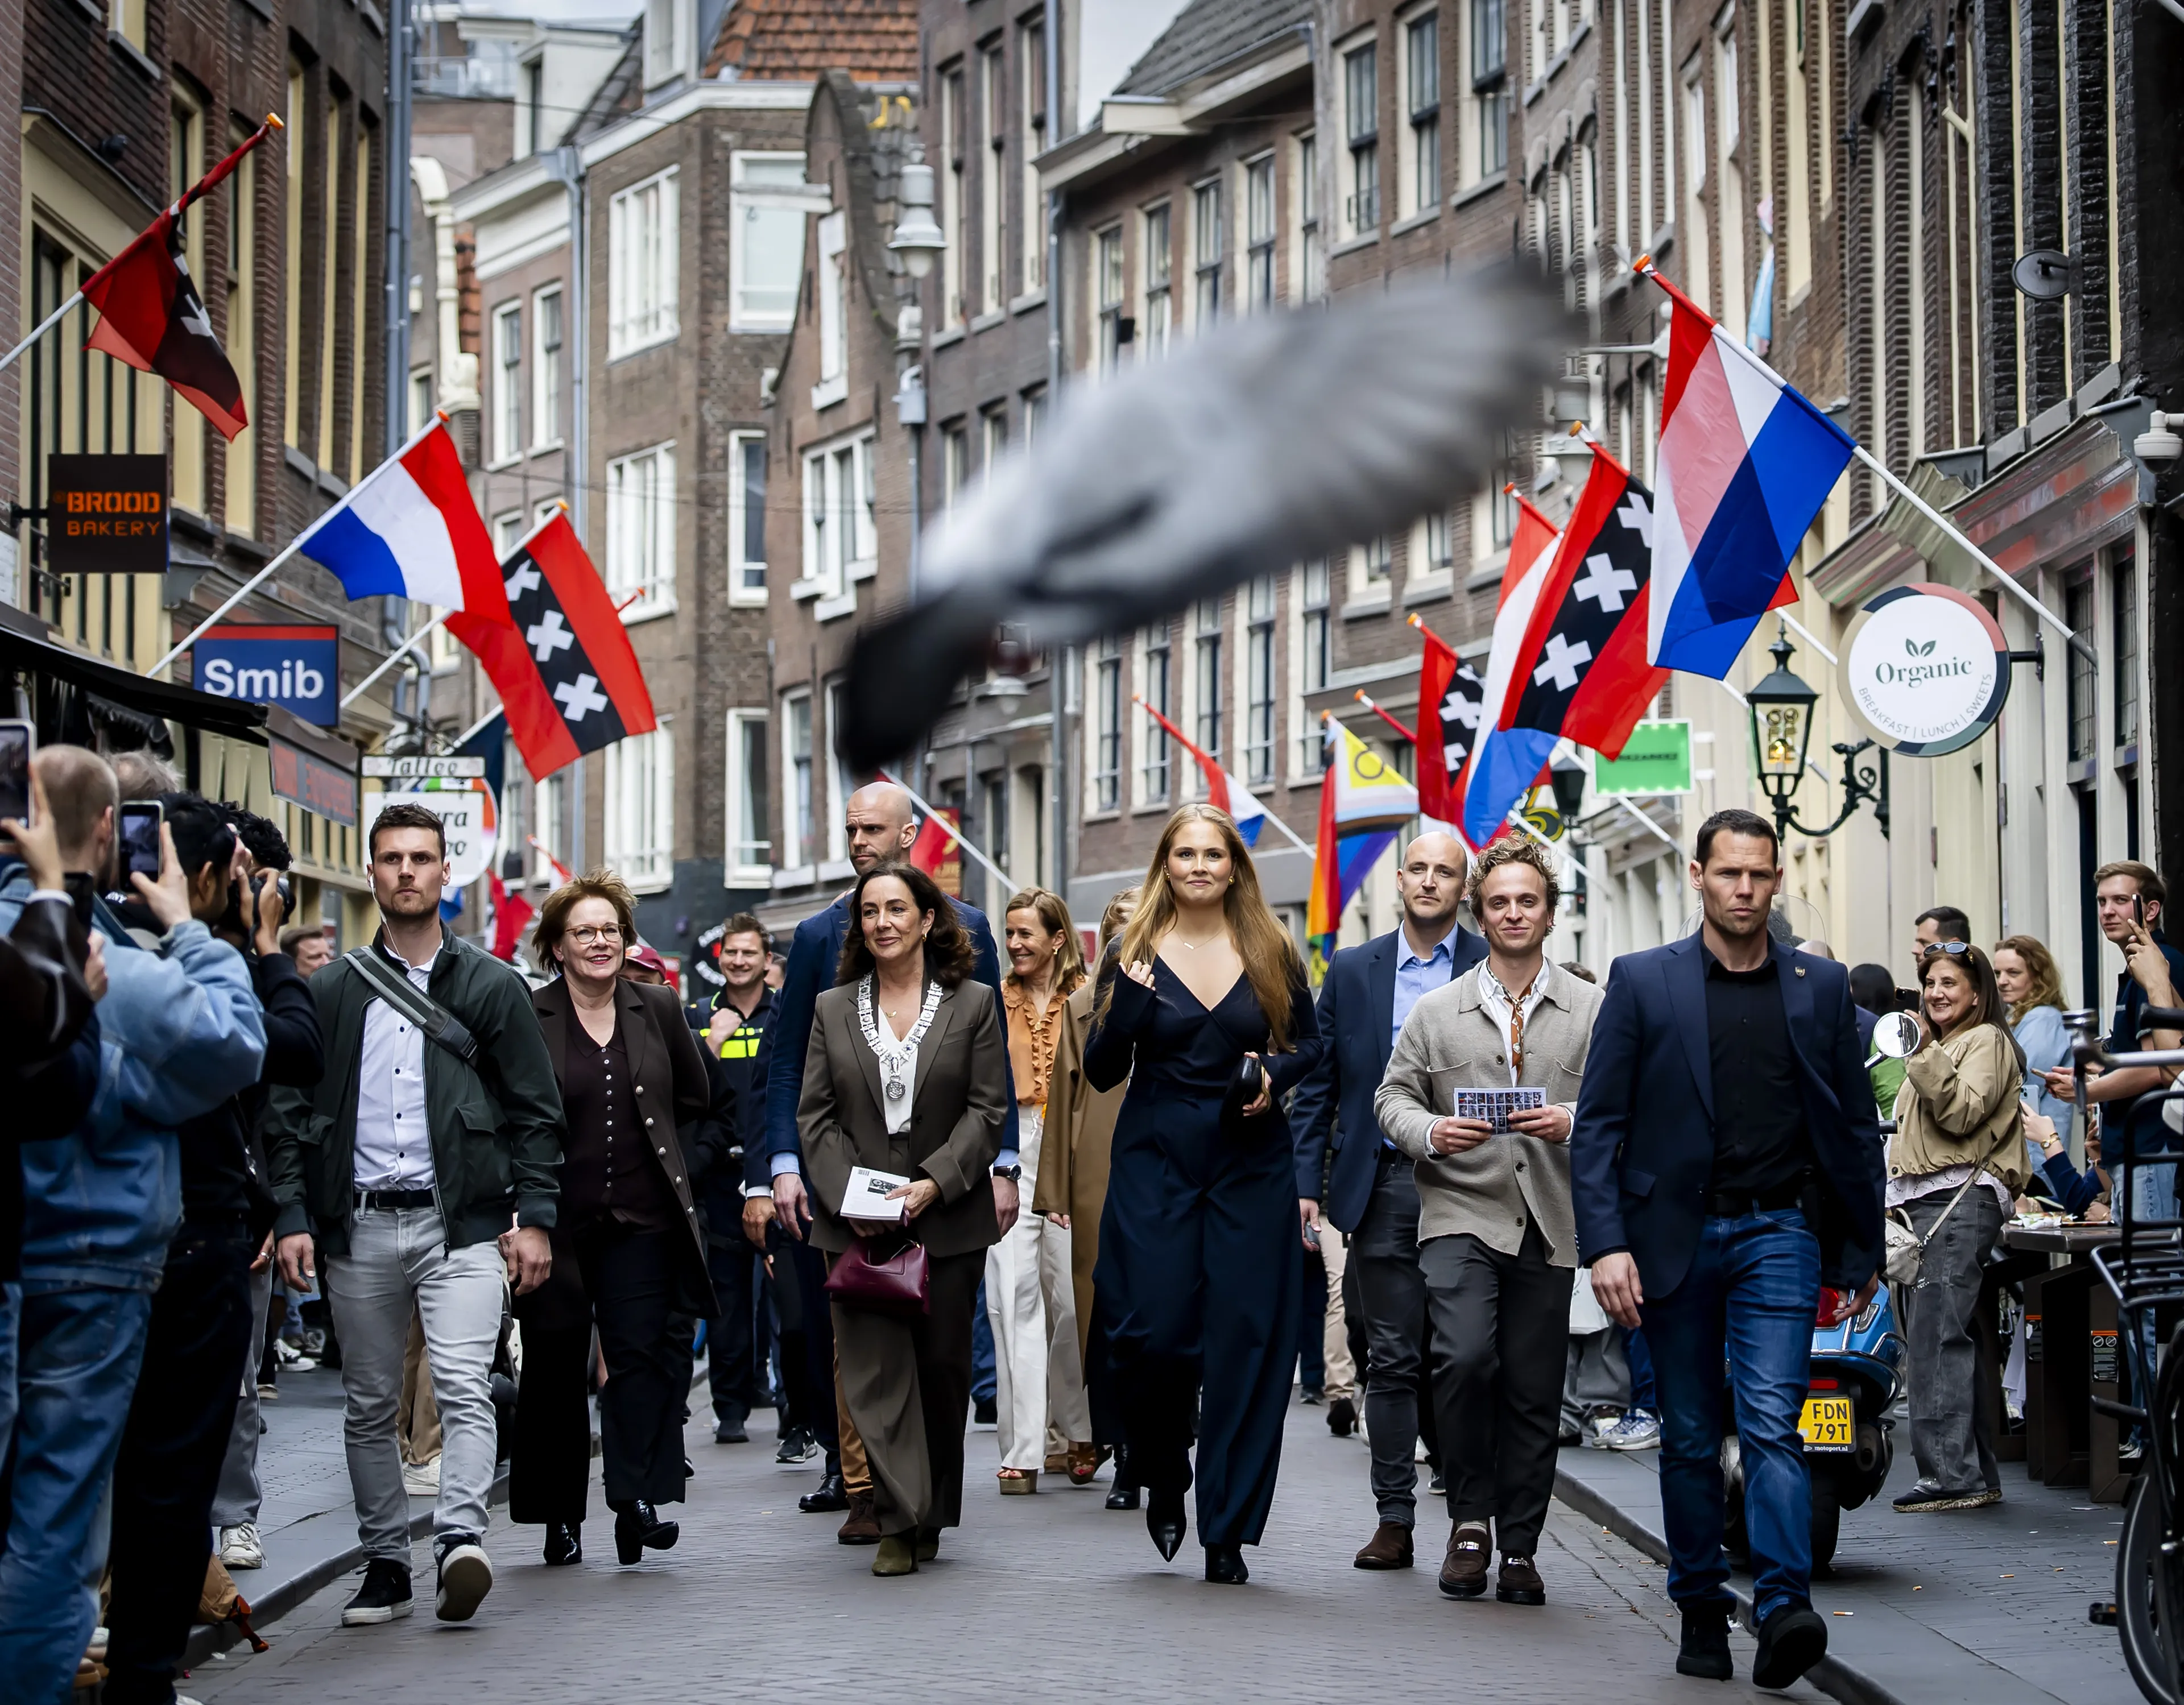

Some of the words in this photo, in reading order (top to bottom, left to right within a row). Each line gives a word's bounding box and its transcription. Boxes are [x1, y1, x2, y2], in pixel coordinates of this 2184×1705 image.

[67, 491, 161, 513] BROOD
[67, 520, 160, 536] BAKERY
[204, 658, 324, 699] Smib
[1876, 657, 1972, 688] Organic
[1859, 687, 1910, 735] BREAKFAST
[1921, 719, 1960, 738] LUNCH
[1966, 673, 1992, 717] SWEETS
[1813, 1403, 1847, 1420] FDN
[1814, 1423, 1847, 1440] 79T
